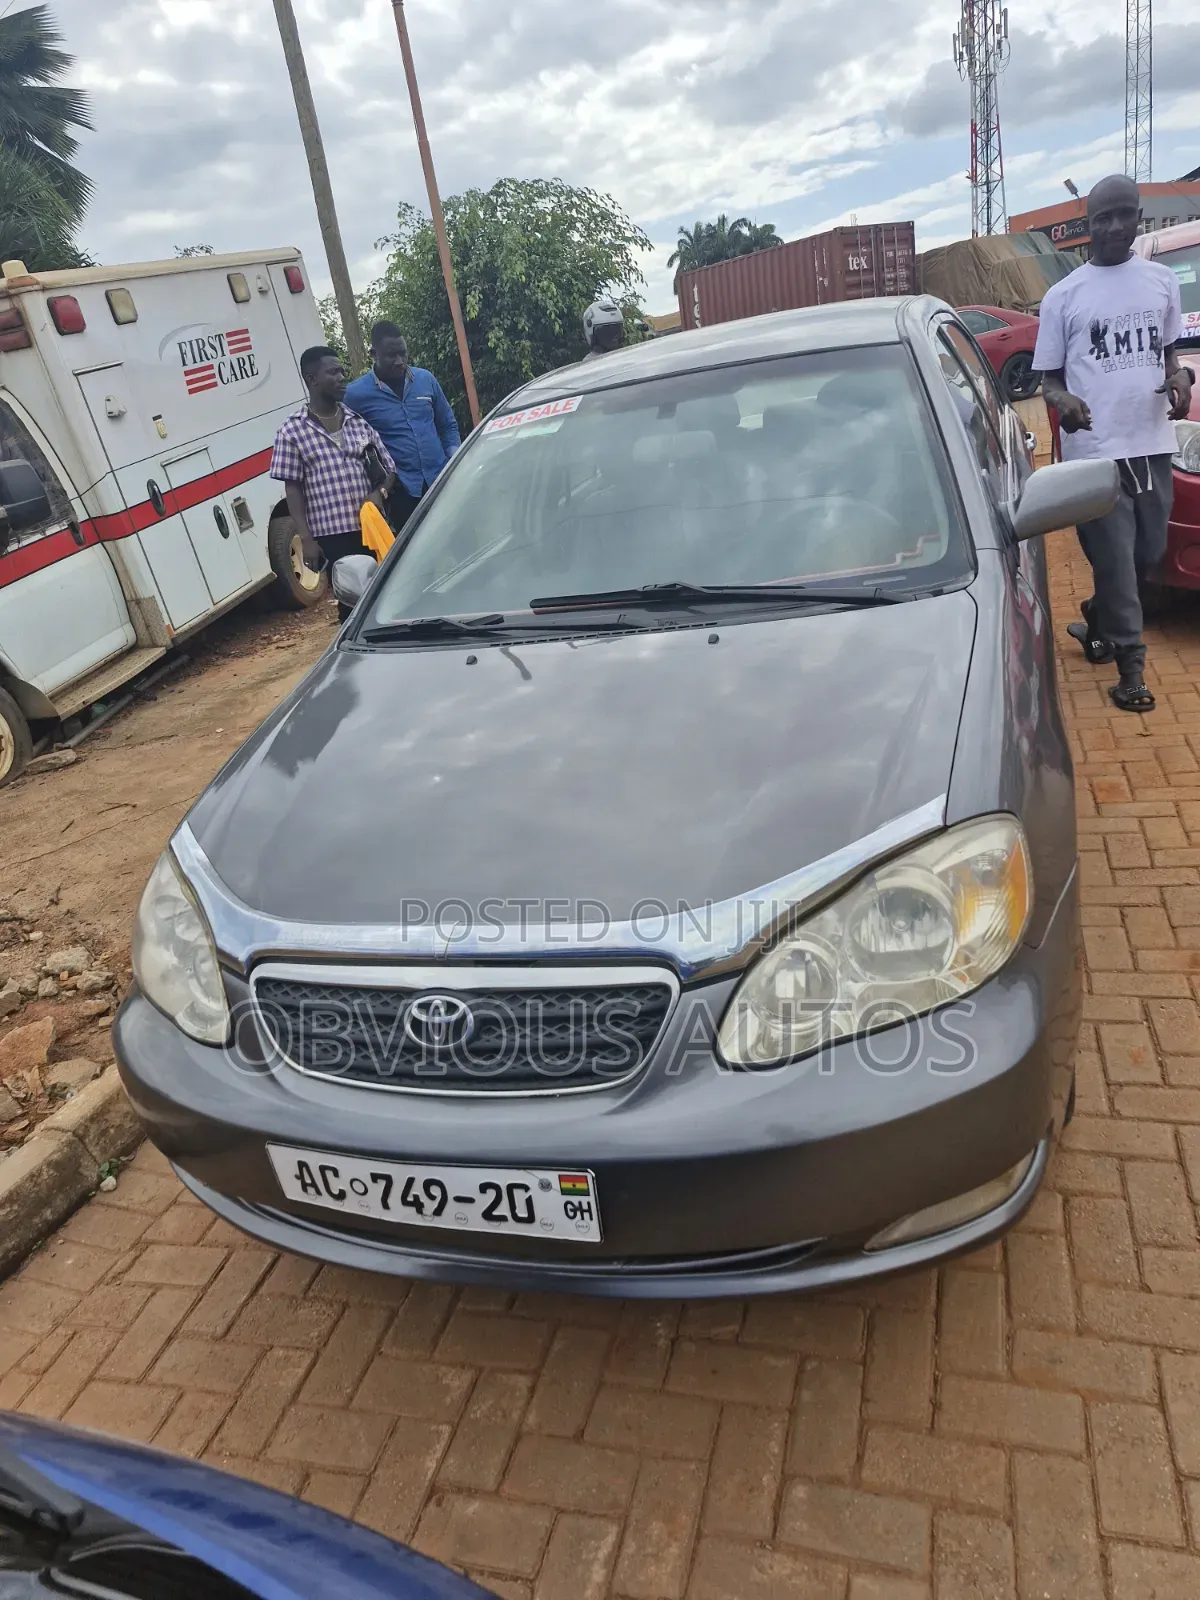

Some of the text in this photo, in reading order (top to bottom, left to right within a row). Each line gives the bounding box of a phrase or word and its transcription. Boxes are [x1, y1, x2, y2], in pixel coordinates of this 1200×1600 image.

[848, 253, 868, 271] tex
[177, 333, 226, 367] FIRST
[217, 353, 259, 386] CARE
[487, 398, 577, 432] FOR SALE
[563, 1200, 593, 1221] GH
